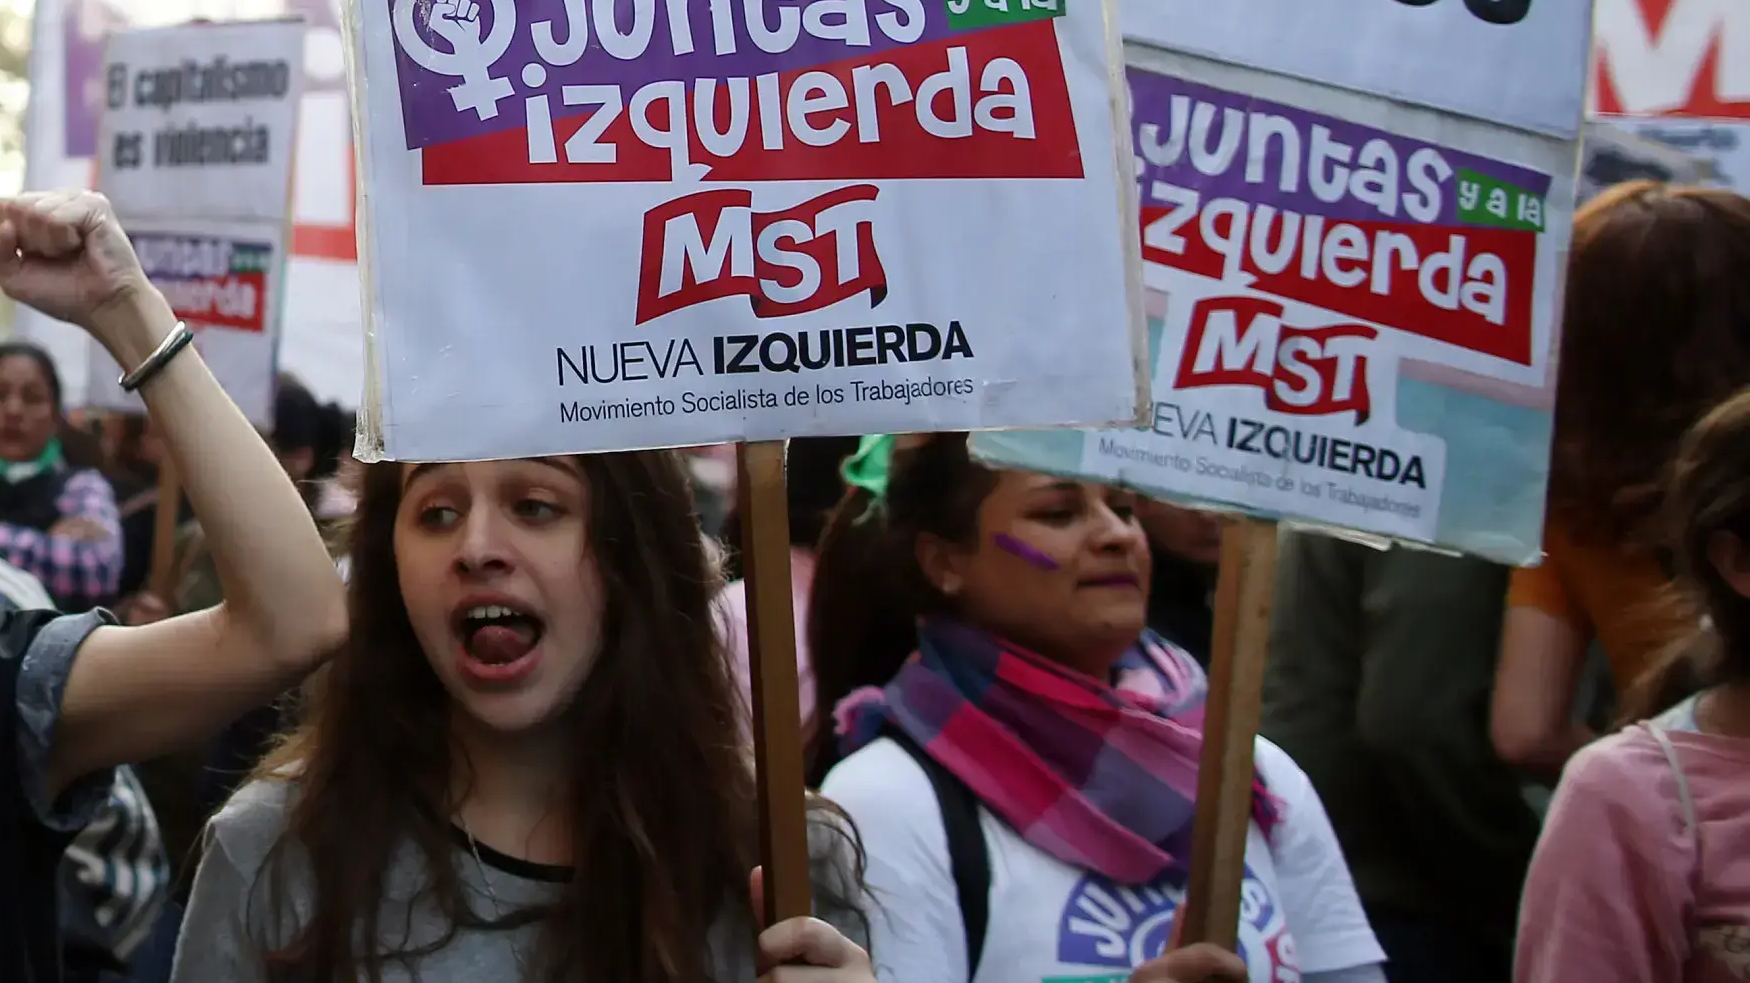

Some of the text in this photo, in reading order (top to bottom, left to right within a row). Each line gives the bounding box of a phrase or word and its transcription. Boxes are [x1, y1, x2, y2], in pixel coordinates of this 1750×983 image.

[521, 47, 1036, 182] izquierda
[659, 199, 878, 305] MST
[1134, 156, 1506, 325] zquierda
[557, 321, 973, 387] NUEVA IZQUIERDA
[560, 375, 973, 423] Movimiento Socialista de los Trabajadores
[1192, 308, 1374, 406] MST
[1099, 438, 1191, 472] Movimiento
[1152, 402, 1426, 489] EVA IZQUIERDA
